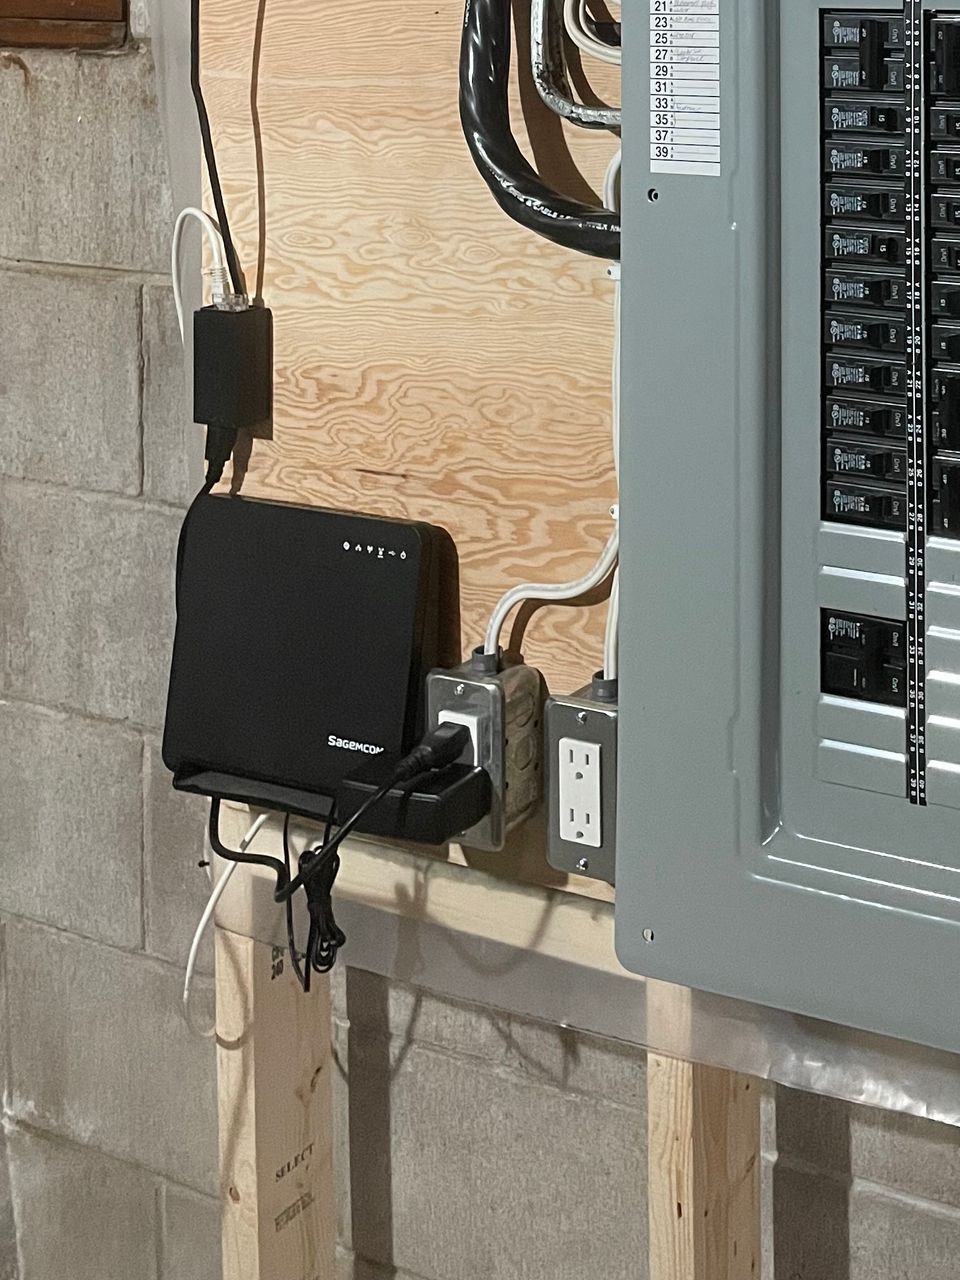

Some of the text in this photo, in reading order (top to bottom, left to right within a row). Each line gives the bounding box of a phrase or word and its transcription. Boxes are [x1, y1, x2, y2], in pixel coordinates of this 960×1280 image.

[654, 0, 666, 12] 21
[654, 16, 668, 28] 23
[656, 32, 668, 44] 25
[656, 48, 668, 60] 27
[656, 66, 668, 76] 29
[656, 82, 666, 92] 31
[656, 98, 668, 108] 33
[656, 114, 668, 124] 35
[656, 130, 668, 140] 37
[656, 146, 668, 158] 39
[276, 1142, 314, 1182] SELECT
